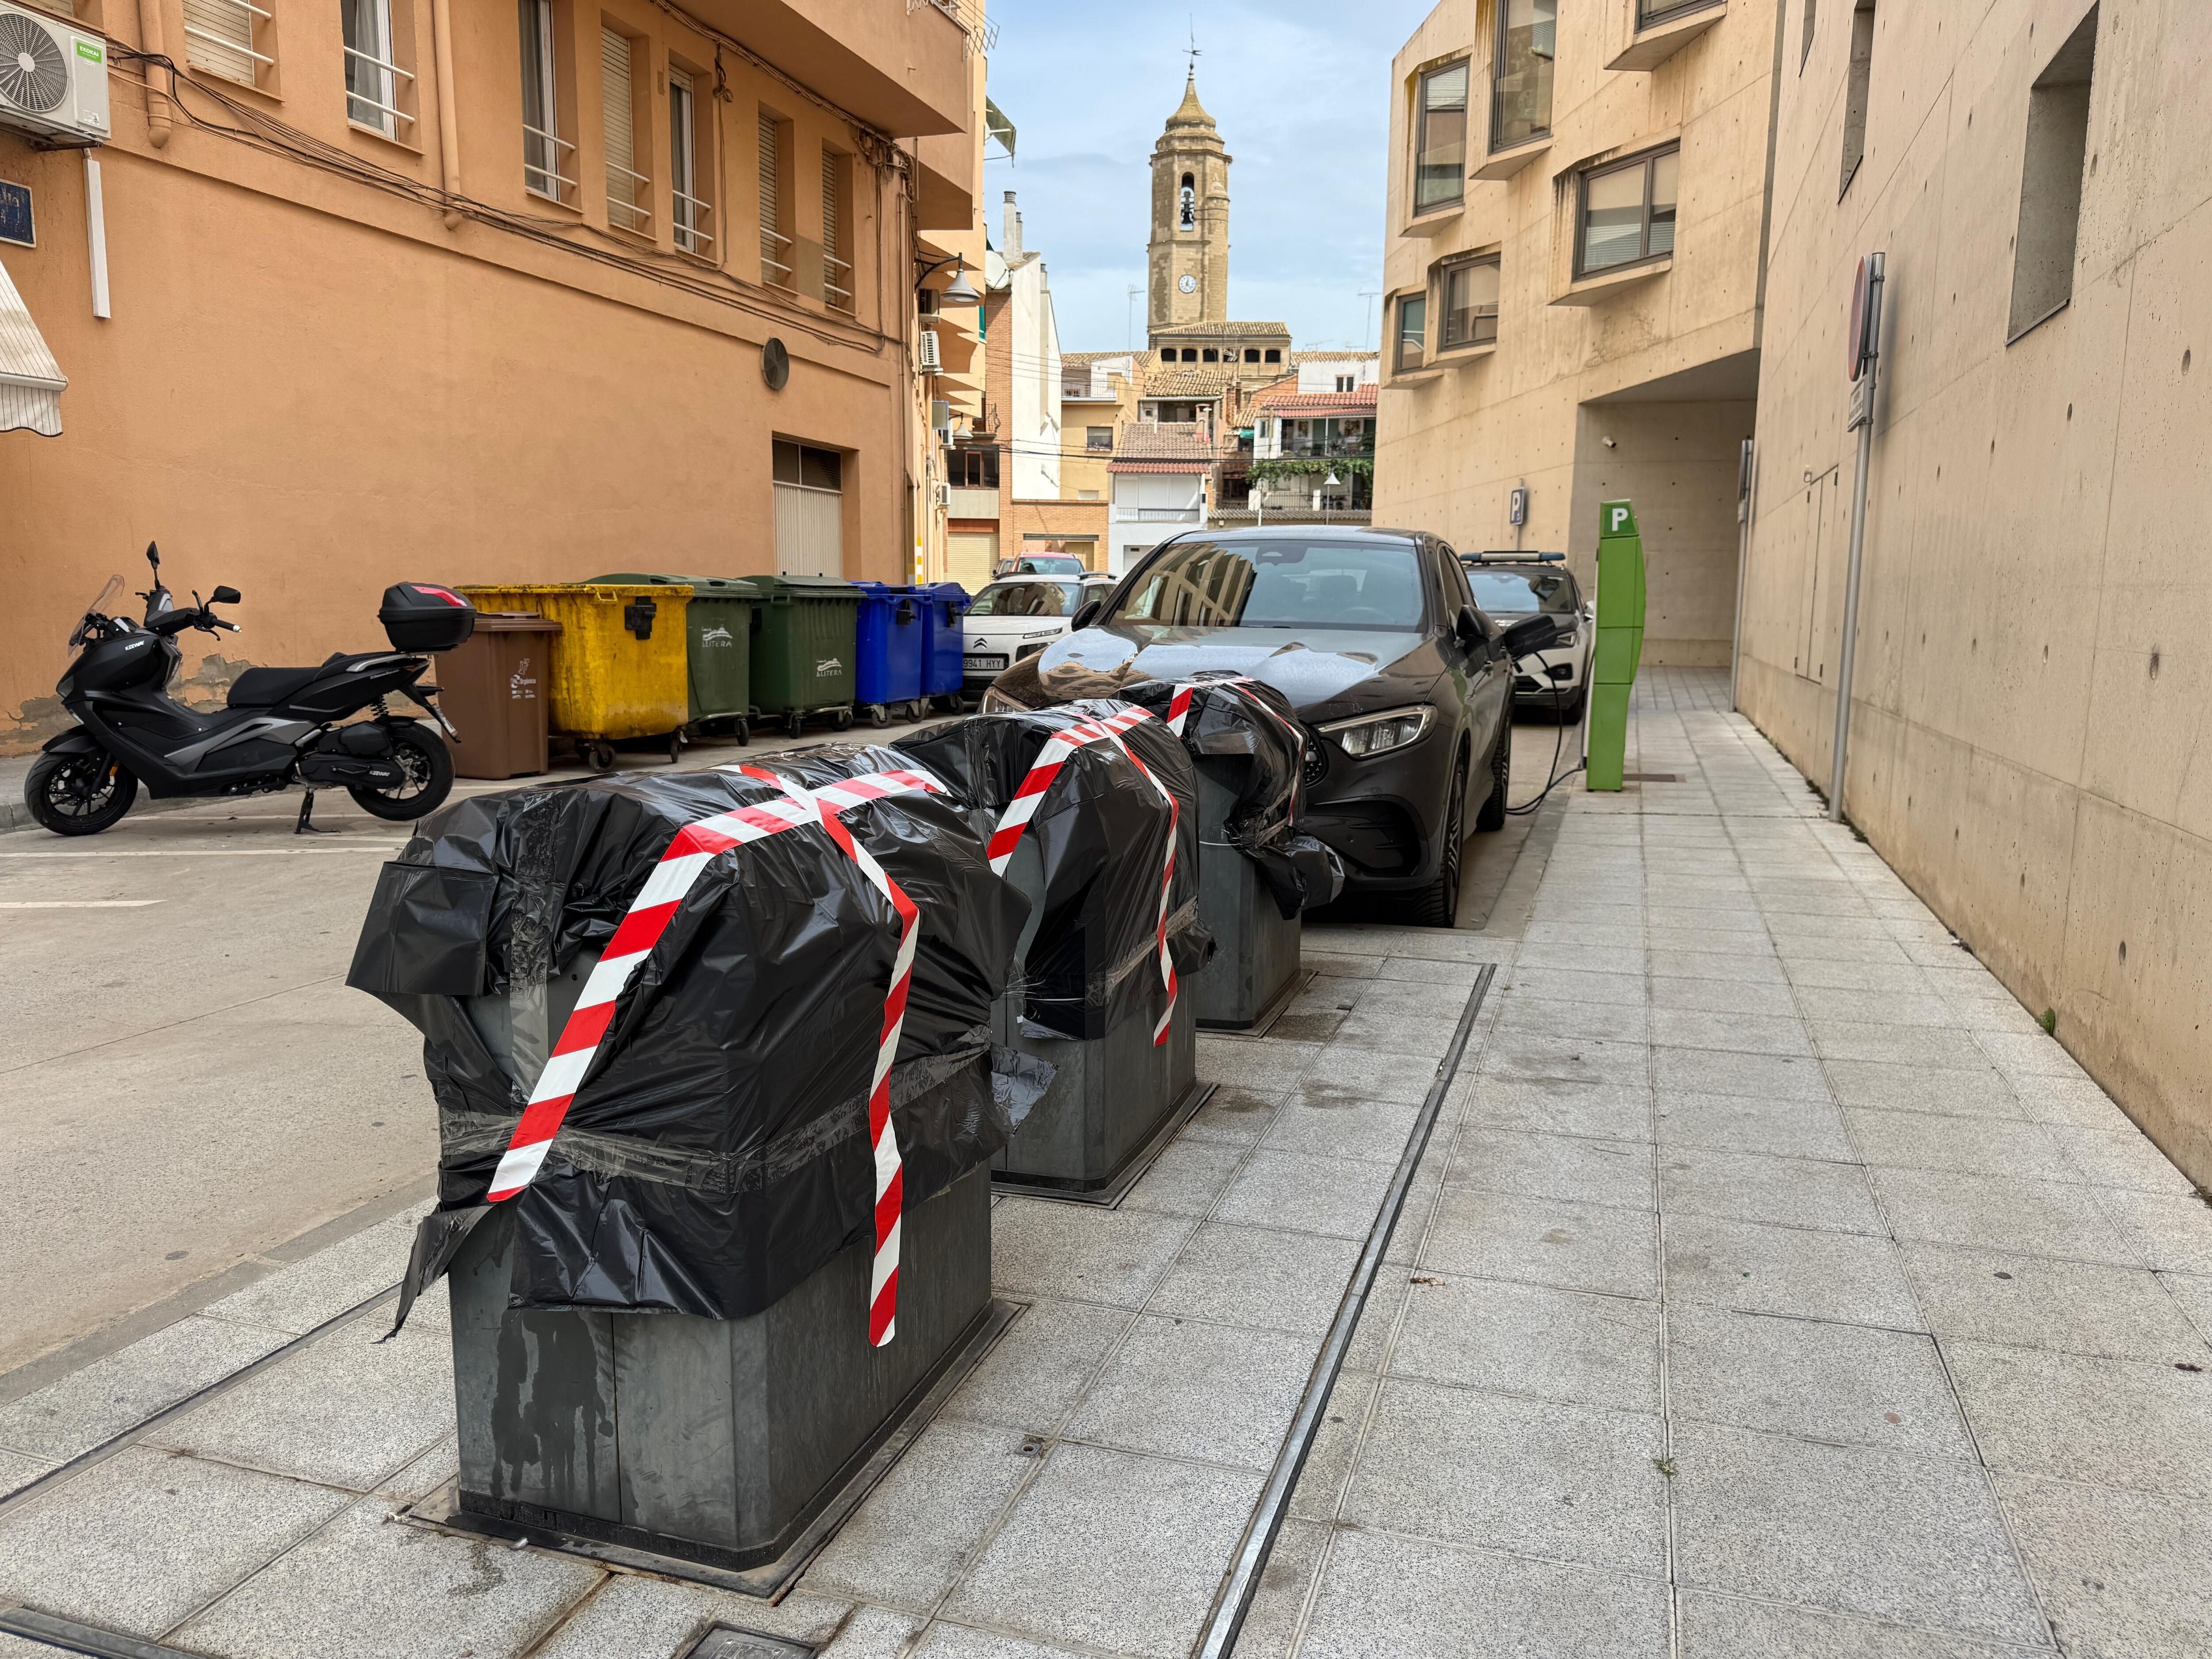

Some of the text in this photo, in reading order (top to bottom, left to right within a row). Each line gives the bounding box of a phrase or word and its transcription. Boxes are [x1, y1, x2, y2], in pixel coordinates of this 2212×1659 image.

[80, 46, 99, 57] EKOKAI
[1511, 492, 1521, 521] P
[1612, 508, 1628, 531] P
[125, 640, 144, 651] KEEWAY
[986, 659, 1001, 668] HYY
